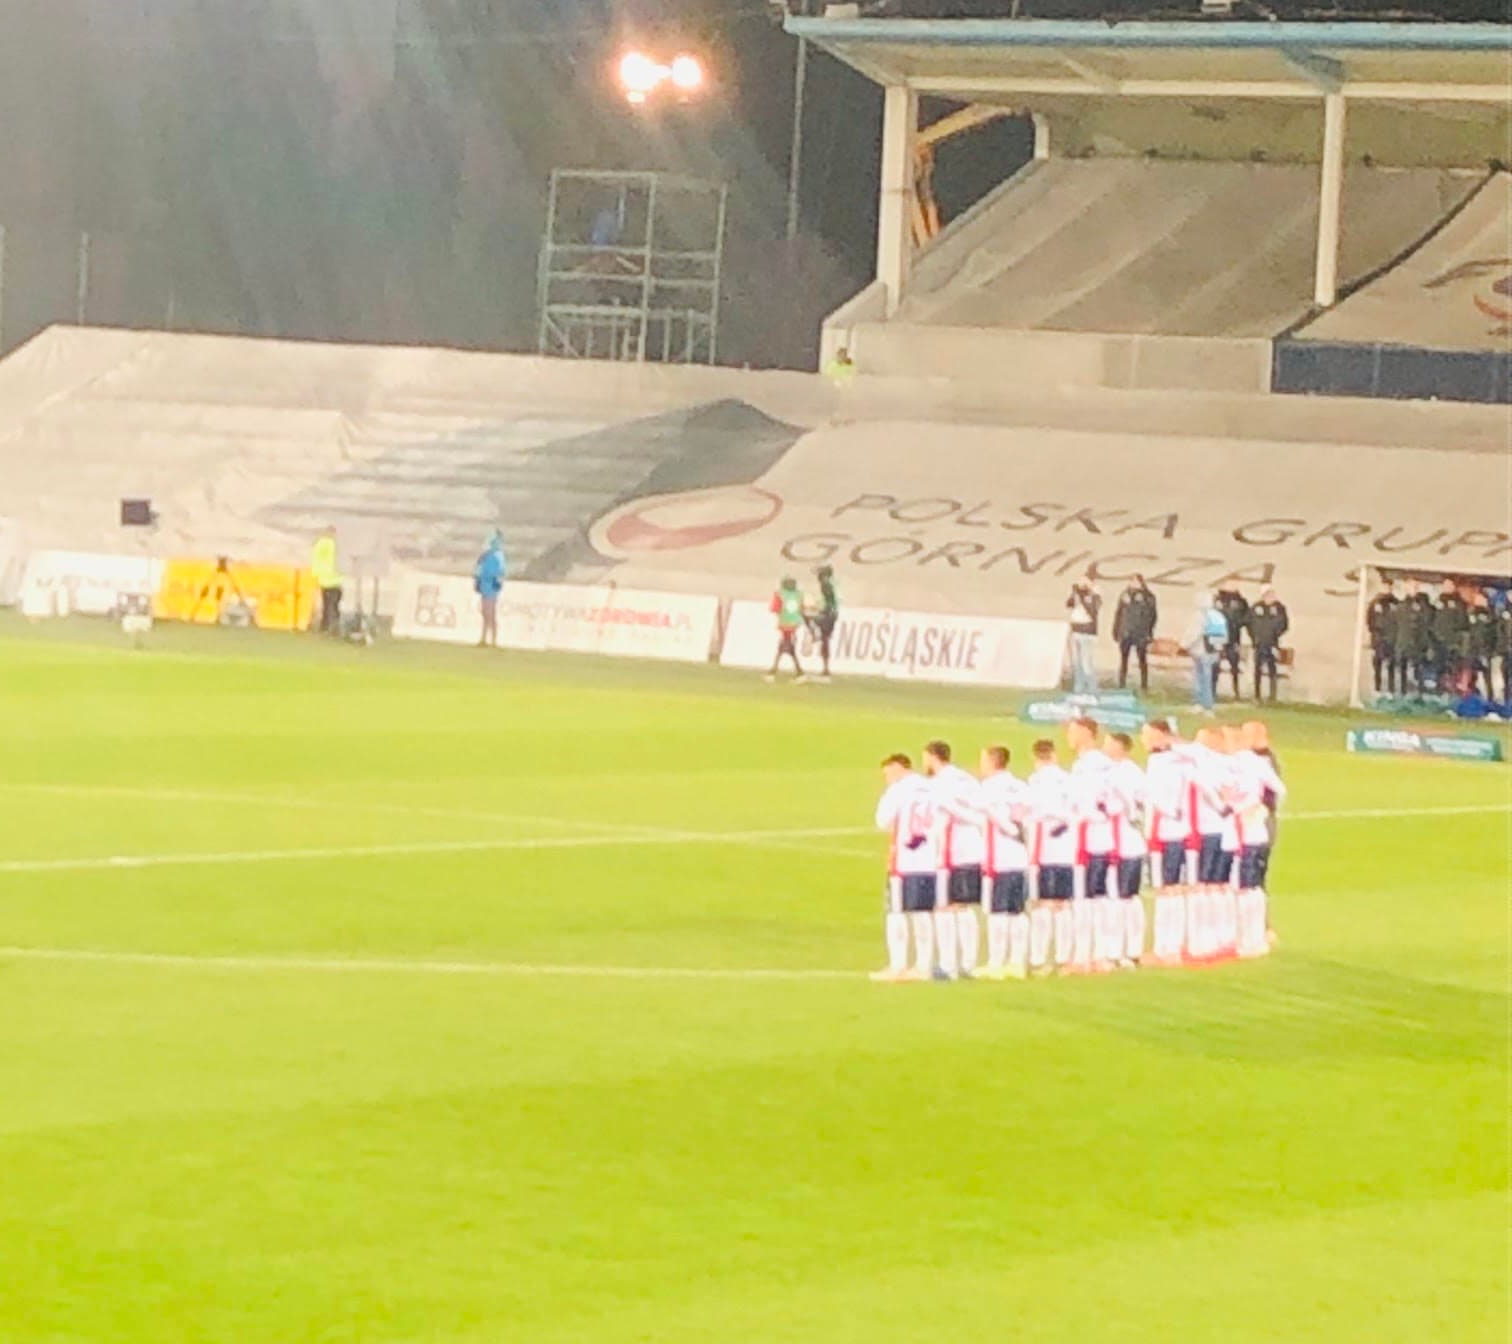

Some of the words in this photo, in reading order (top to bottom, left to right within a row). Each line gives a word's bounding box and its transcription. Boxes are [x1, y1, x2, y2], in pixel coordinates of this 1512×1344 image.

[830, 493, 1180, 539] POLSKA
[780, 529, 1275, 588] GÓRNICZA
[800, 611, 986, 674] NOŚLĄSKIE
